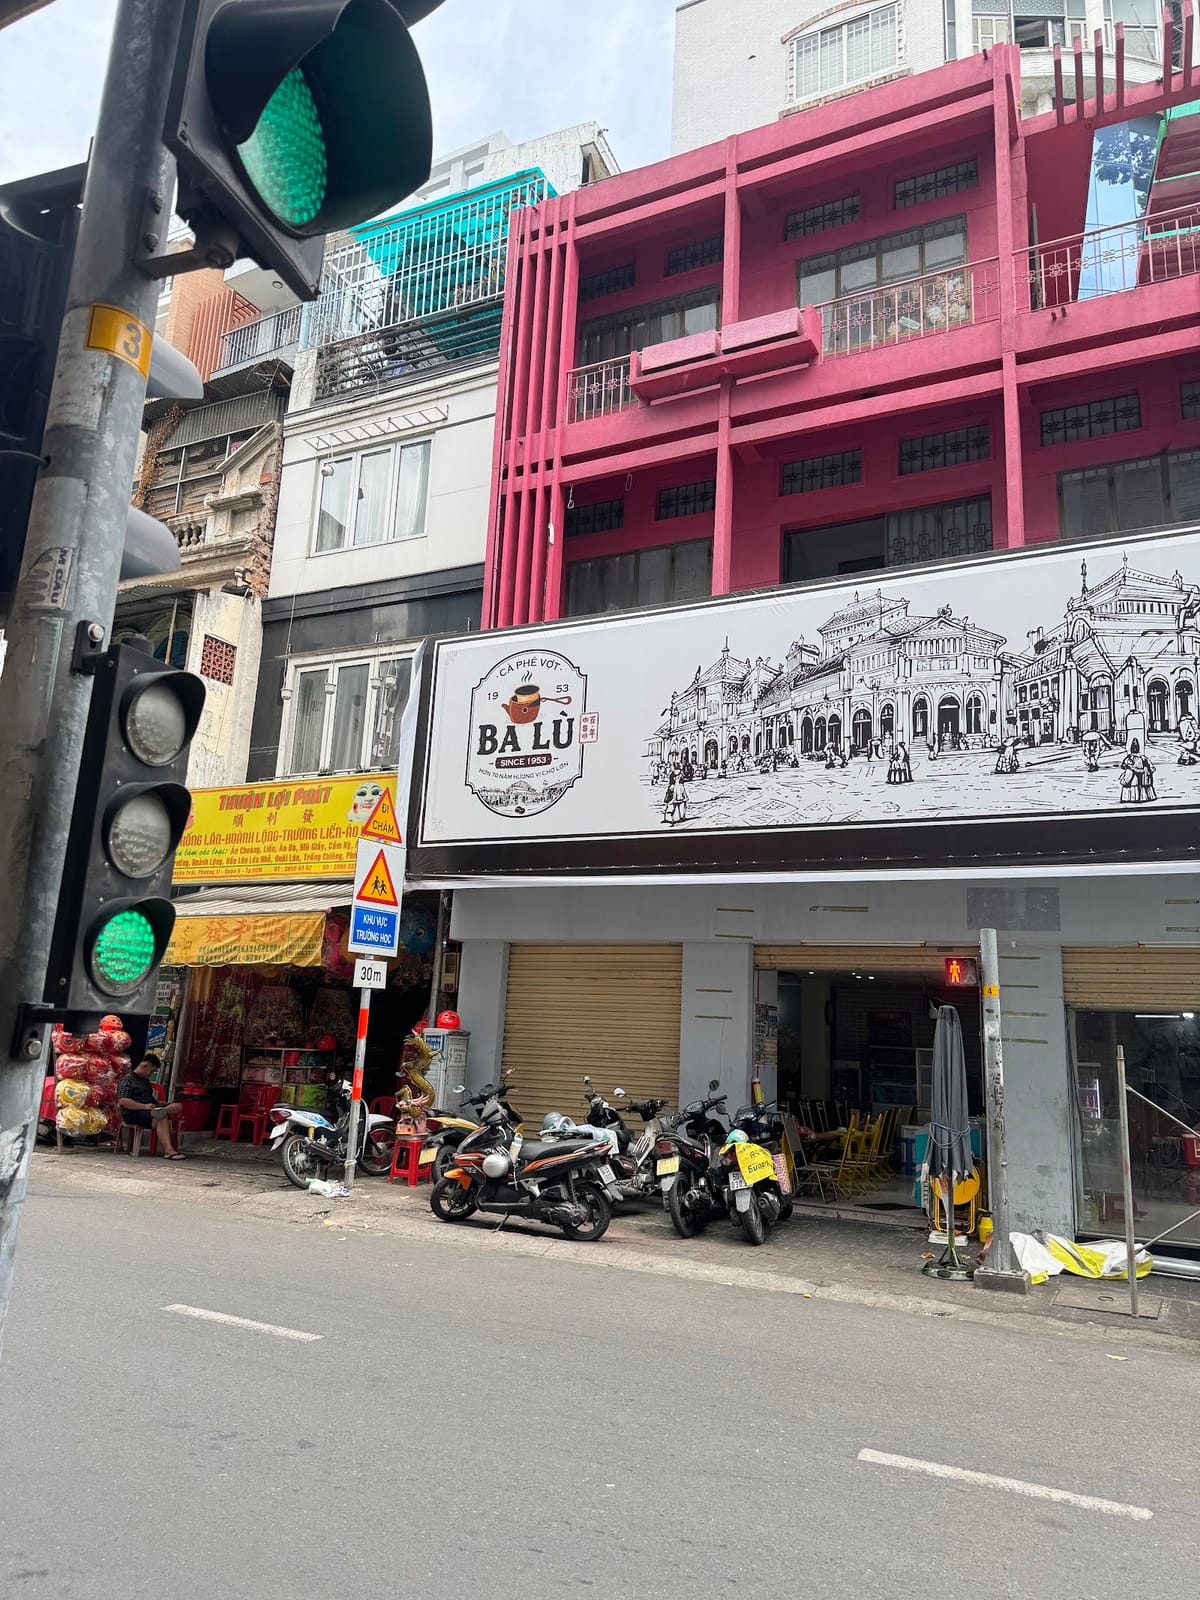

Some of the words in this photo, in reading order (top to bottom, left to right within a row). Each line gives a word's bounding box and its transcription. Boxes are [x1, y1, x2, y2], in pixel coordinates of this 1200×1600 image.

[123, 323, 142, 359] 3
[499, 663, 515, 677] CÀ
[516, 656, 538, 670] PHÊ
[488, 691, 499, 700] 19
[556, 684, 569, 694] 53
[477, 724, 521, 756] BA
[532, 710, 575, 750] LÙ
[500, 758, 525, 767] SINCE
[527, 756, 547, 765] 1953
[219, 790, 266, 812] THUẬN
[267, 788, 292, 810] LỢI
[292, 785, 332, 806] PHÁT
[382, 803, 390, 814] ĐI
[362, 914, 376, 926] KHU
[356, 928, 380, 942] TRƯỜNG
[380, 932, 392, 945] HỌC
[987, 987, 992, 996] 4
